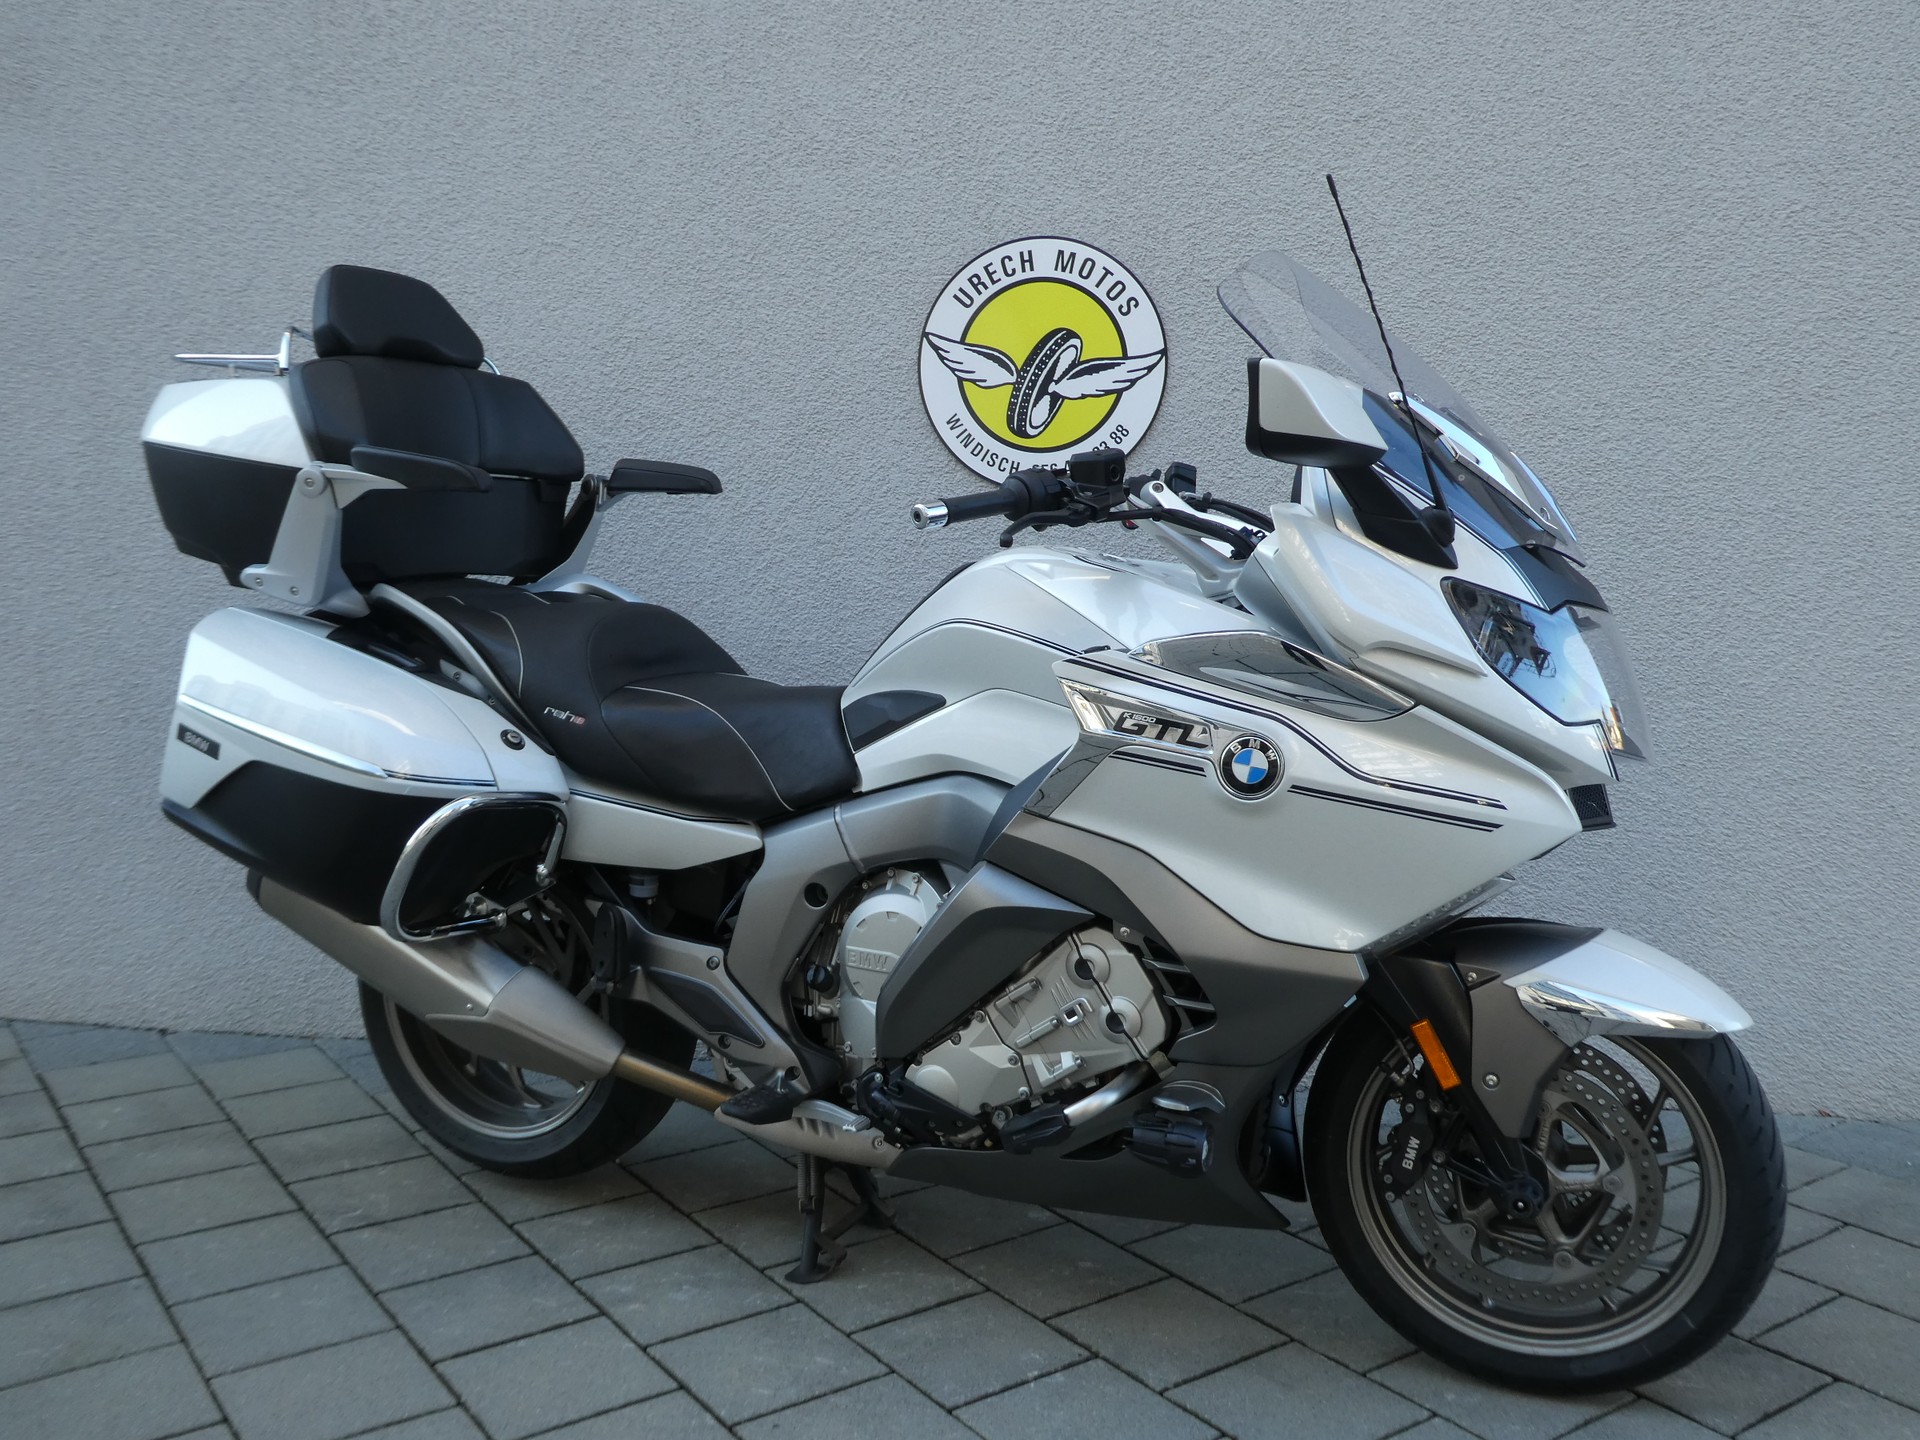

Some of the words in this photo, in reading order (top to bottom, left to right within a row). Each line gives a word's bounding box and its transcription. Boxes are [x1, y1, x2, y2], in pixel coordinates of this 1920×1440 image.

[952, 250, 1035, 309] URECH
[1054, 249, 1140, 317] MOTOS
[946, 413, 1021, 475] WINDISCH
[1109, 424, 1130, 445] 88
[1113, 711, 1209, 749] GTL
[1132, 714, 1157, 723] 1600
[1230, 738, 1277, 760] BMW
[848, 951, 888, 970] BMW
[1402, 1136, 1420, 1170] BMW
